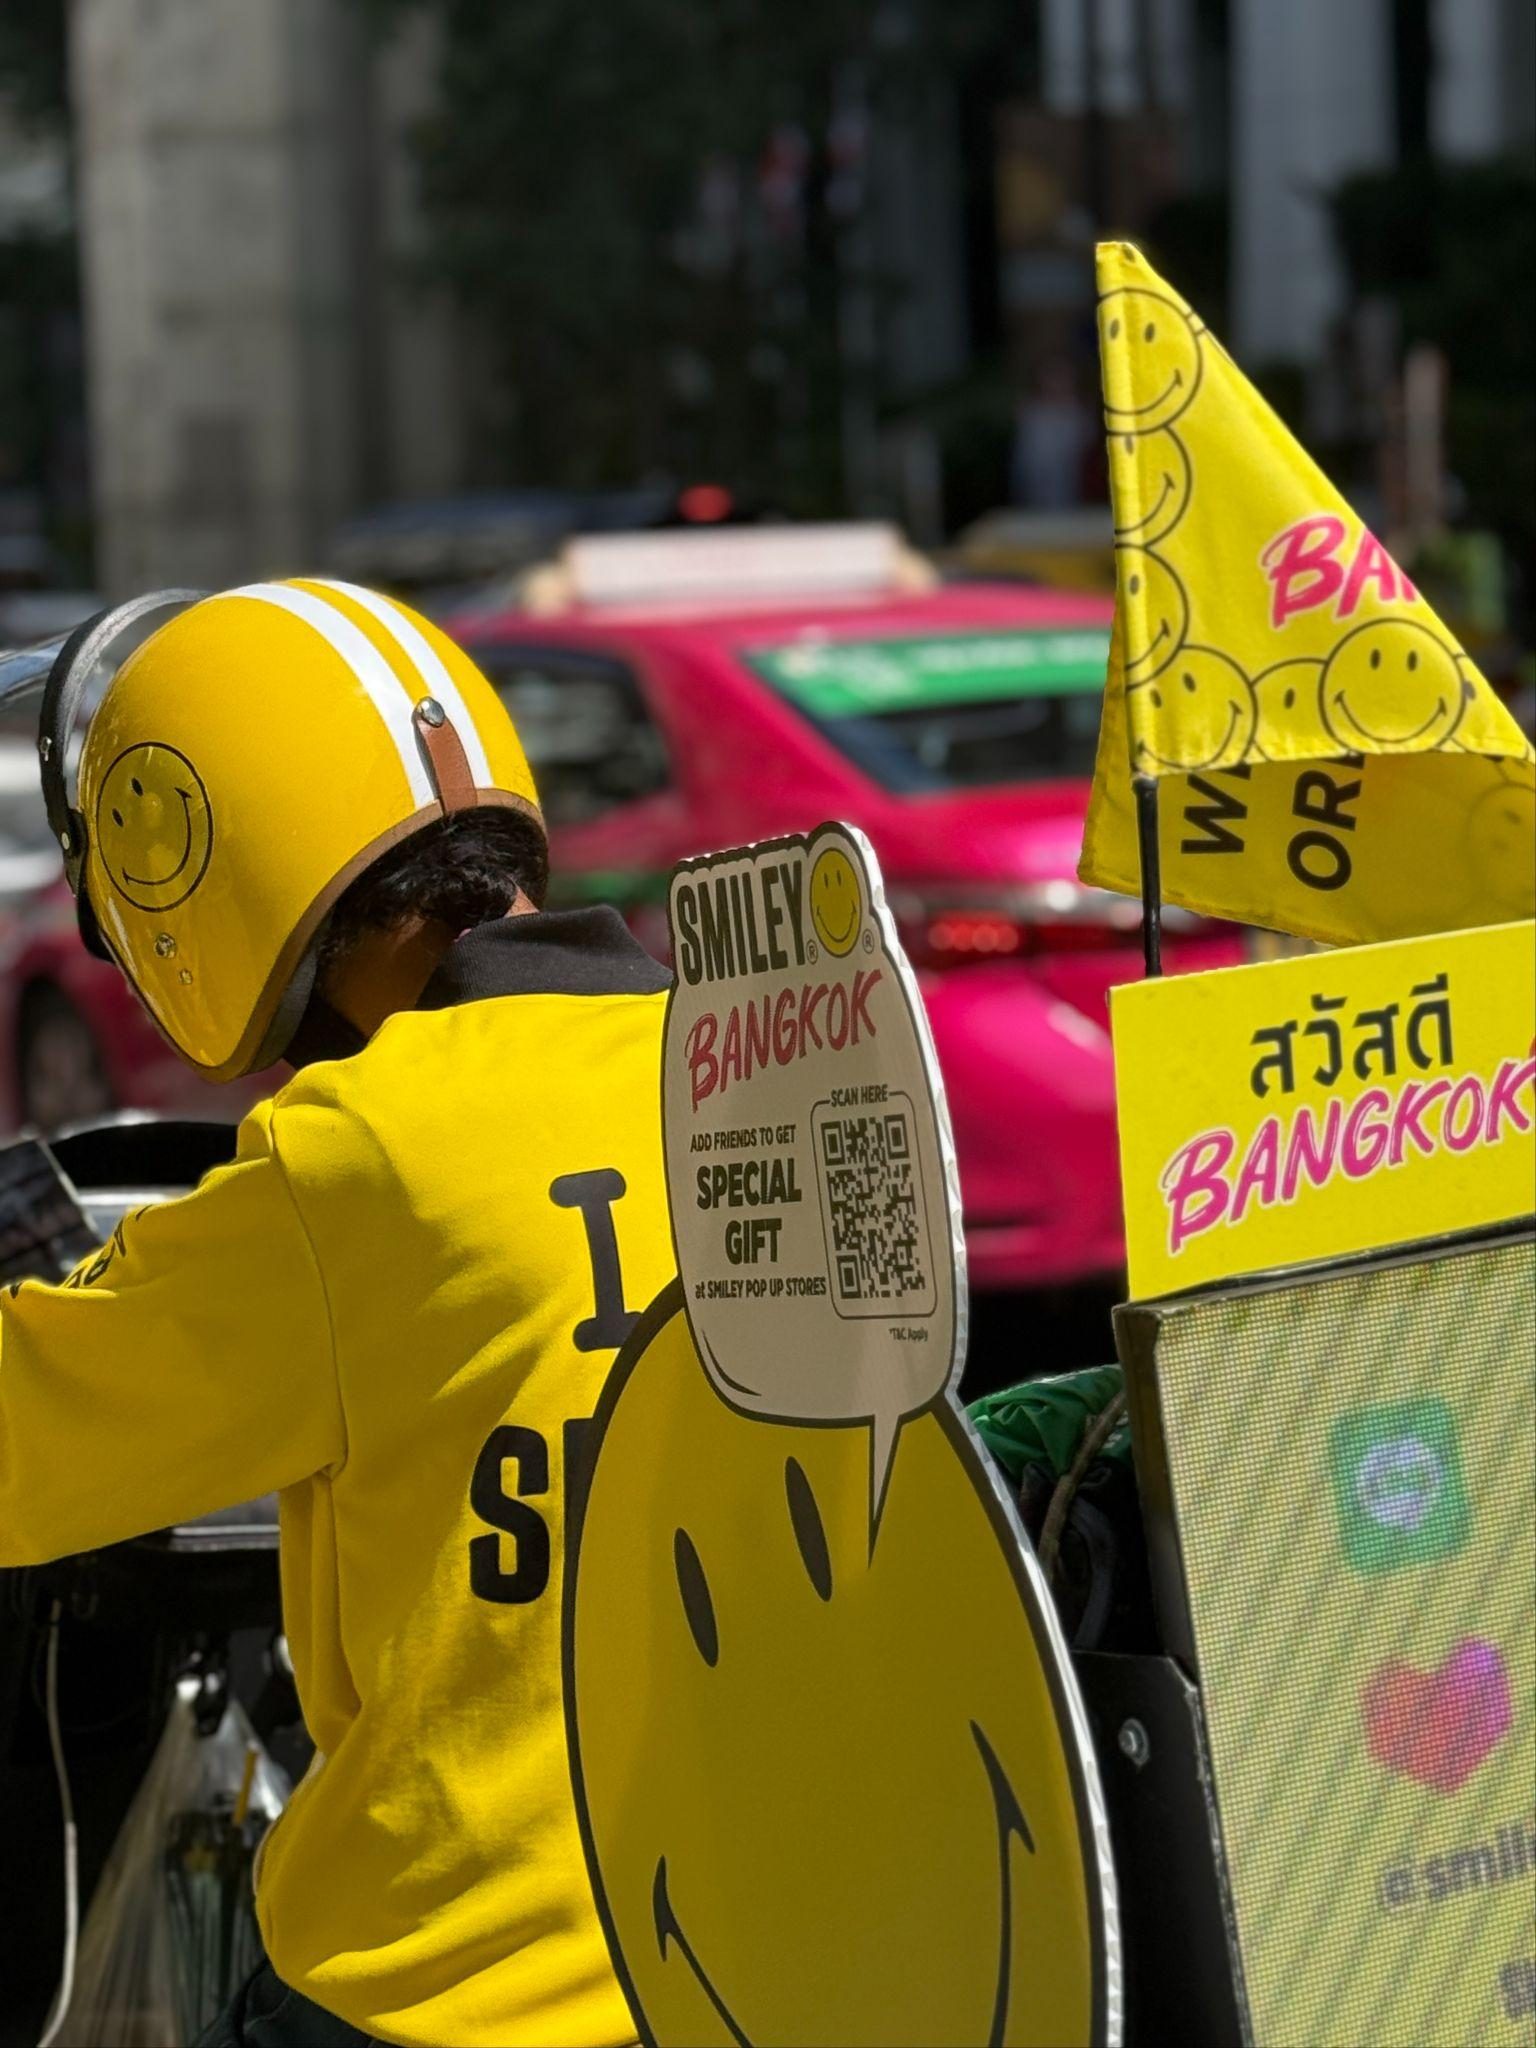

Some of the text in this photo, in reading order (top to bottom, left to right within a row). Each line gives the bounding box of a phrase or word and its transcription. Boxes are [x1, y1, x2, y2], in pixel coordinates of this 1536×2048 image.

[1181, 763, 1252, 855] W
[1287, 754, 1365, 891] OR
[684, 968, 883, 1114] BANGKOK
[1250, 972, 1454, 1099] สวัสดี
[831, 1084, 889, 1108] SCAN HERE
[690, 1124, 797, 1153] ADD FRIENDS TO GET
[1162, 1060, 1536, 1256] BANGKOK
[696, 1157, 802, 1210] SPECIAL
[549, 1168, 643, 1352] I
[725, 1217, 782, 1265] GIFT
[695, 1276, 826, 1300] at SMILEY POP UP STORES
[907, 1326, 928, 1343] Apply
